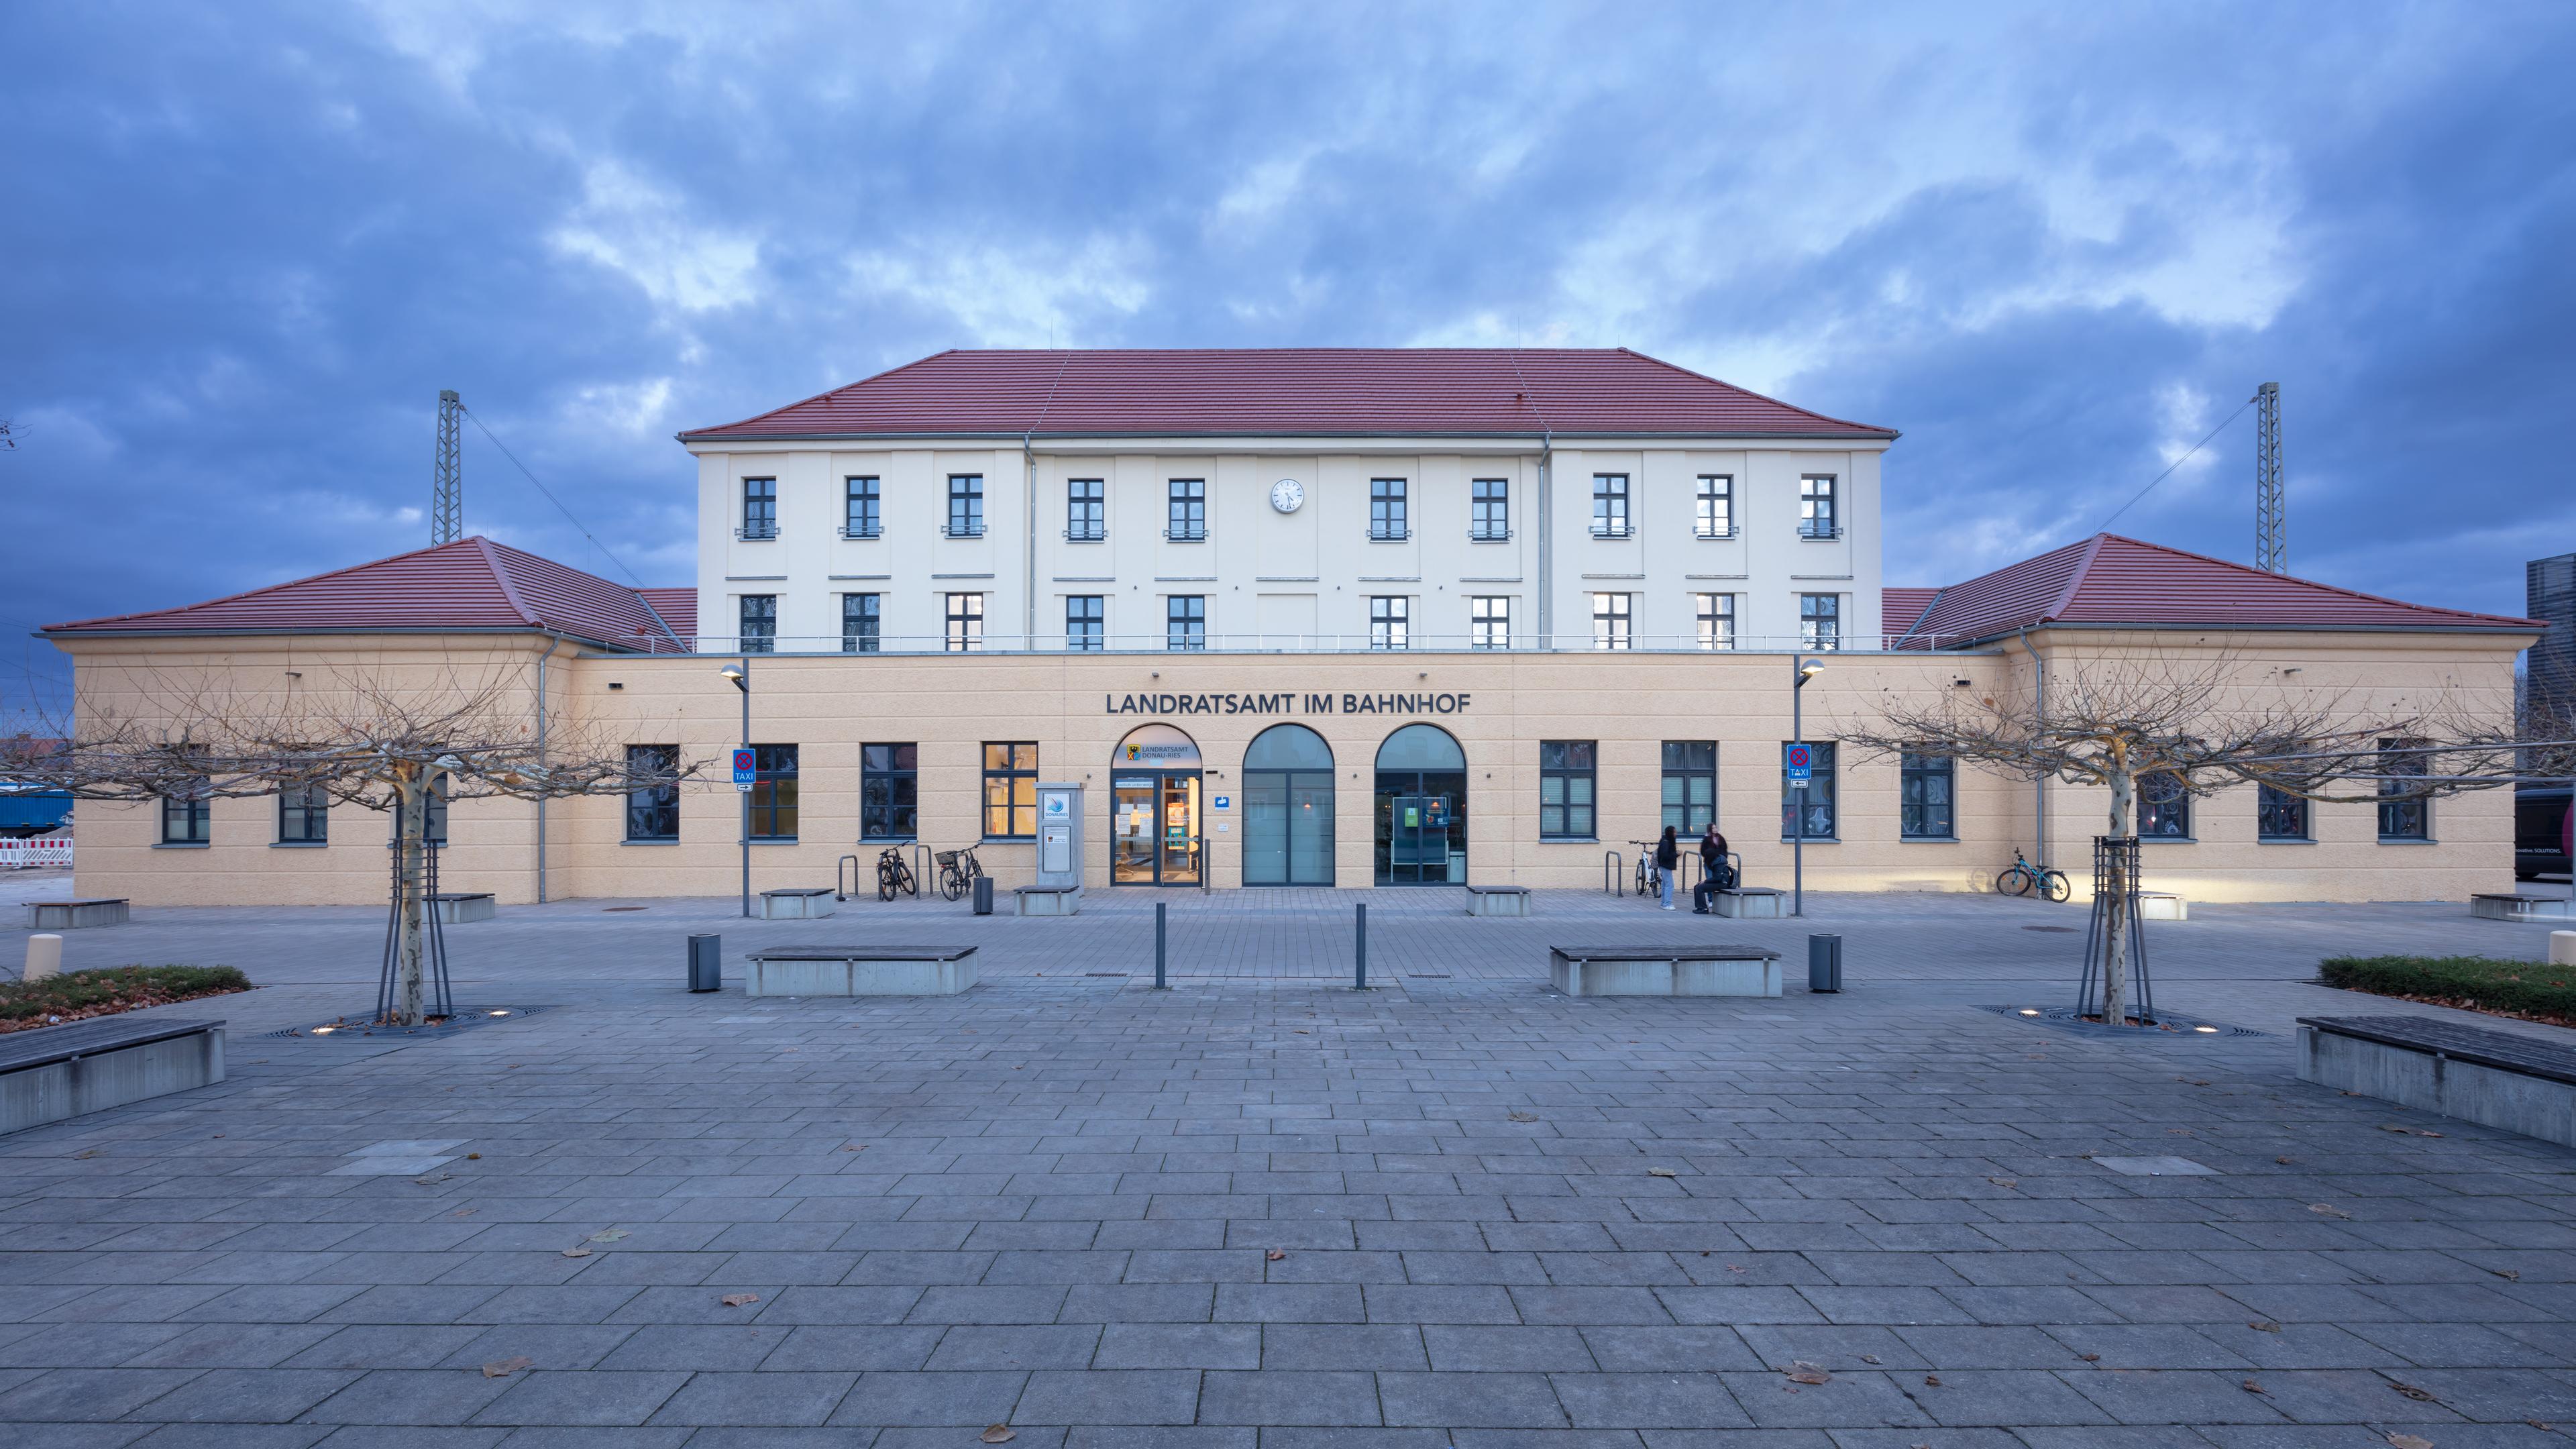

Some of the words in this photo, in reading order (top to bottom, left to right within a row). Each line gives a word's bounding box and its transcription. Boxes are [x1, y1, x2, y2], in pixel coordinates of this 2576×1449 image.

[1106, 694, 1296, 714] LANDRATSAMT
[1304, 694, 1333, 714] IM
[1342, 693, 1470, 714] BAHNHOF
[735, 772, 753, 780] TAXI
[1790, 768, 1809, 776] TAXI
